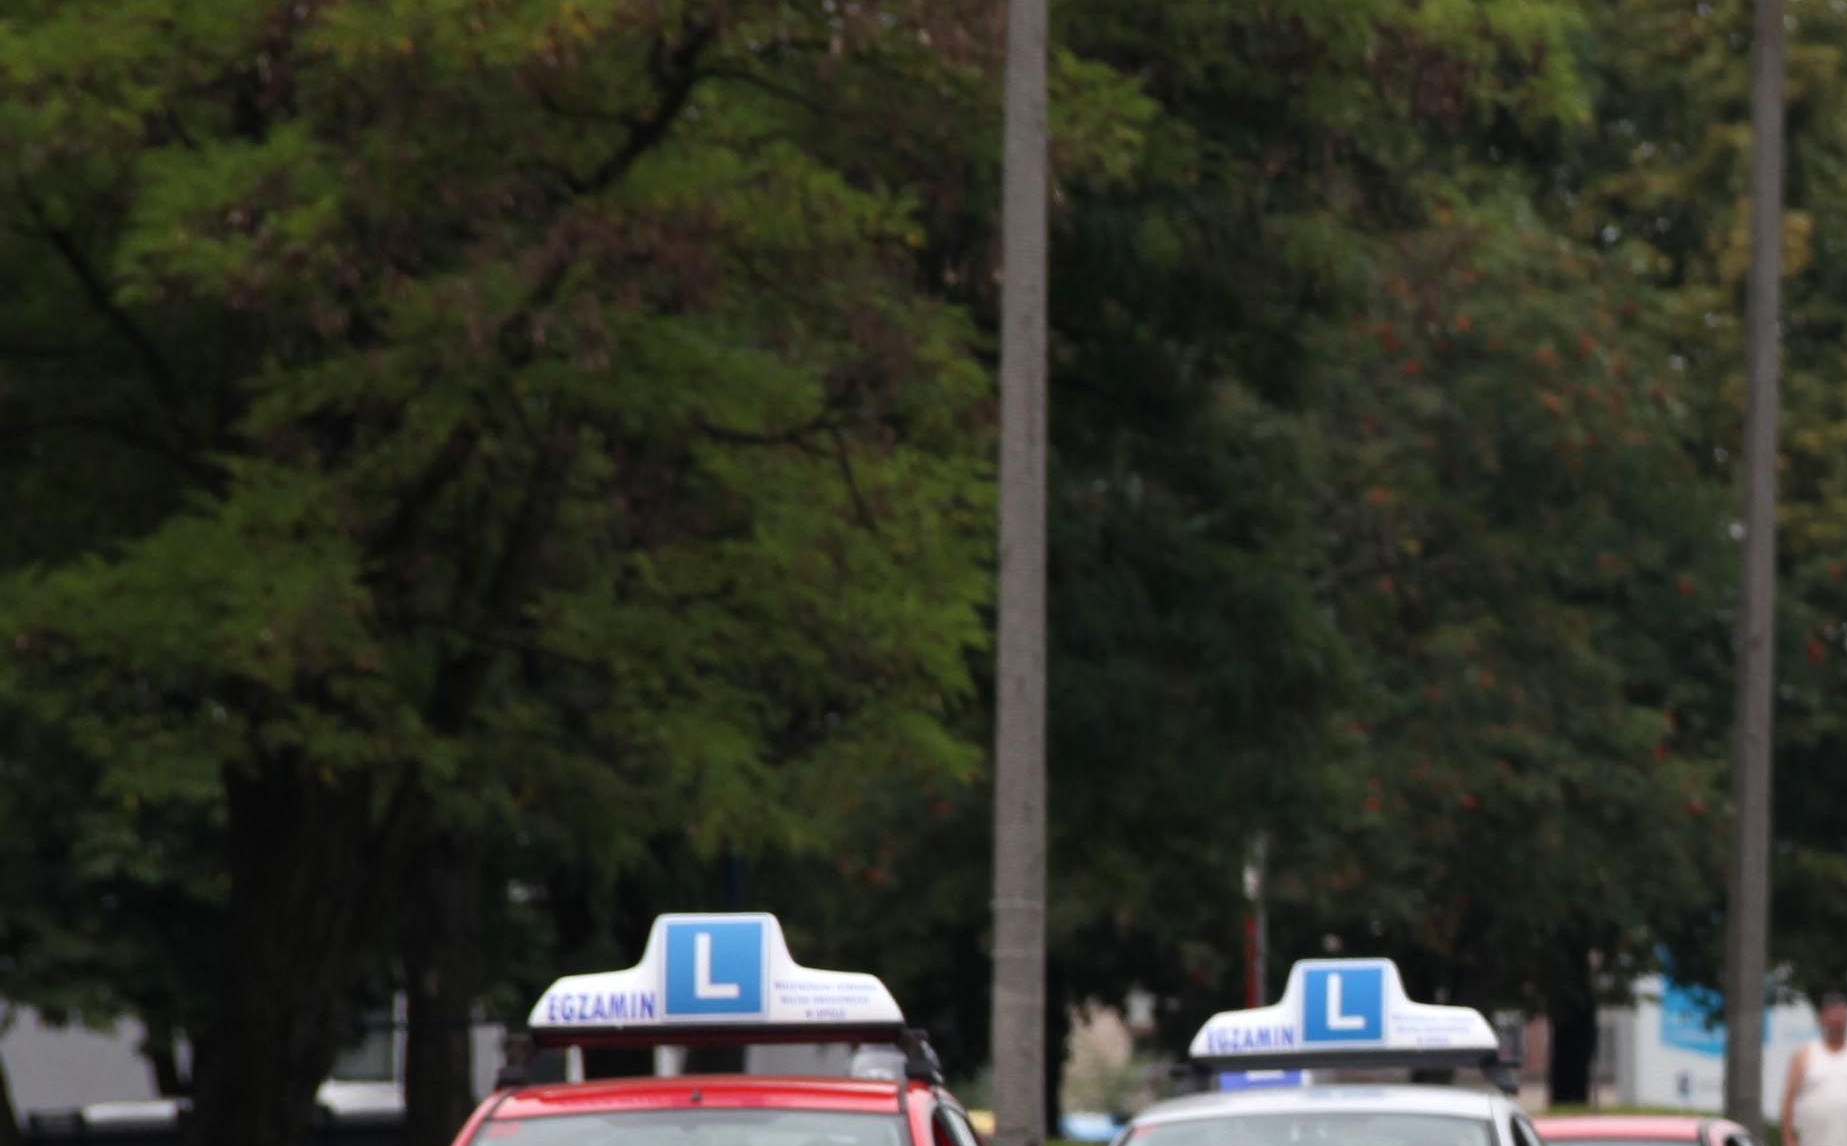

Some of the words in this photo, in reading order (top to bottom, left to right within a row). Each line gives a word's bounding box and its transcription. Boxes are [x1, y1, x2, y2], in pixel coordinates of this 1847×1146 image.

[693, 931, 740, 999] L
[548, 989, 657, 1022] EGZAMIN
[1325, 971, 1367, 1031] L
